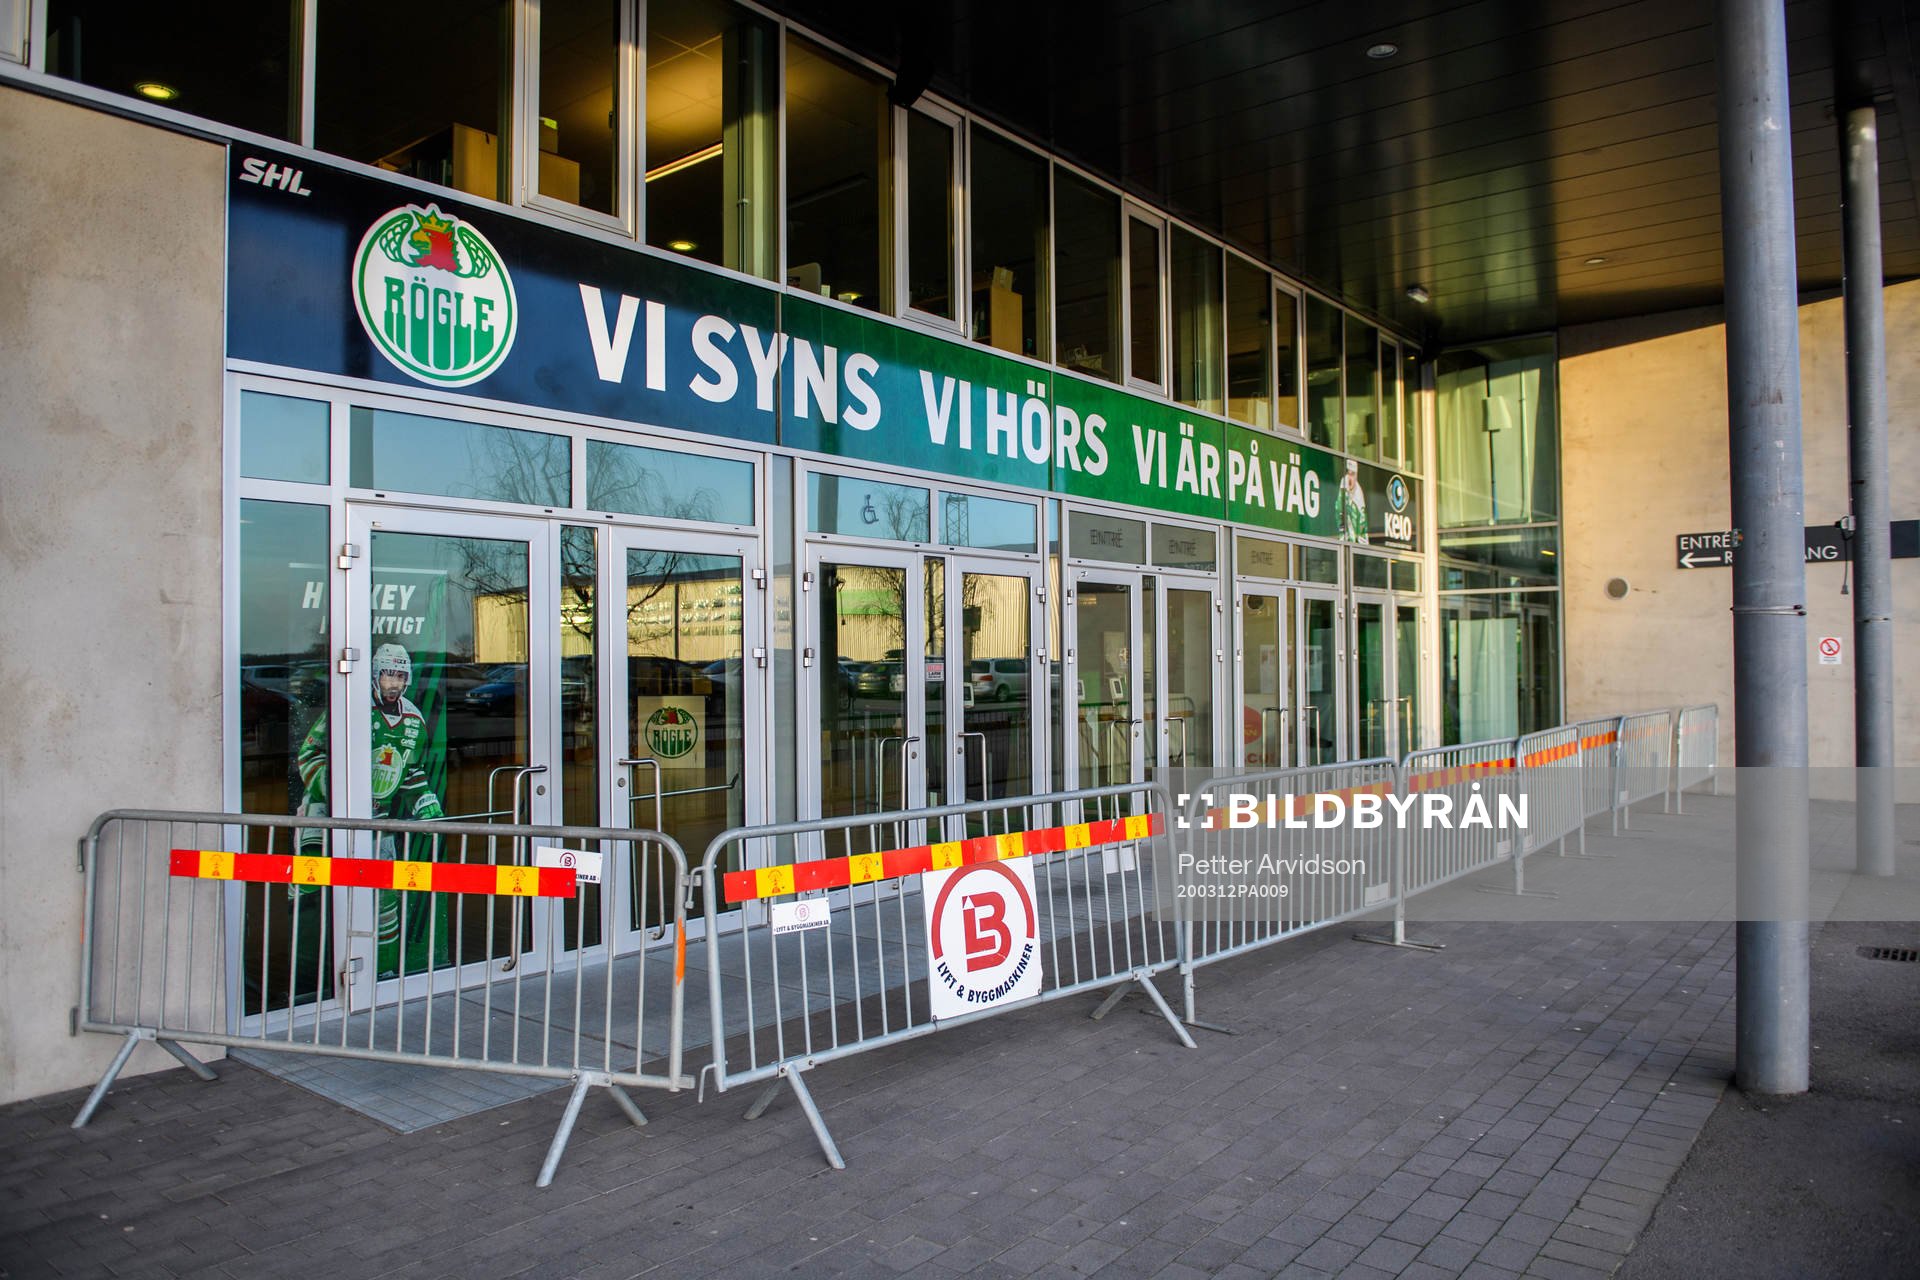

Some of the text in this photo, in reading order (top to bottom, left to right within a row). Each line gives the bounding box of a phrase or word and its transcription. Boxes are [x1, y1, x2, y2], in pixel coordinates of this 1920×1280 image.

[239, 157, 312, 196] SHL
[383, 276, 496, 371] RÖGLE
[578, 283, 1320, 519] VI SYNS VI HÖRS VI ÄR PÅ VÄG
[1680, 531, 1730, 550] ENTRÉ
[302, 581, 416, 611] HKEY
[652, 727, 692, 756] RÖGLE
[372, 766, 396, 793] ÖGLE
[937, 943, 1033, 1003] LYFT & BYGGMASKINER
